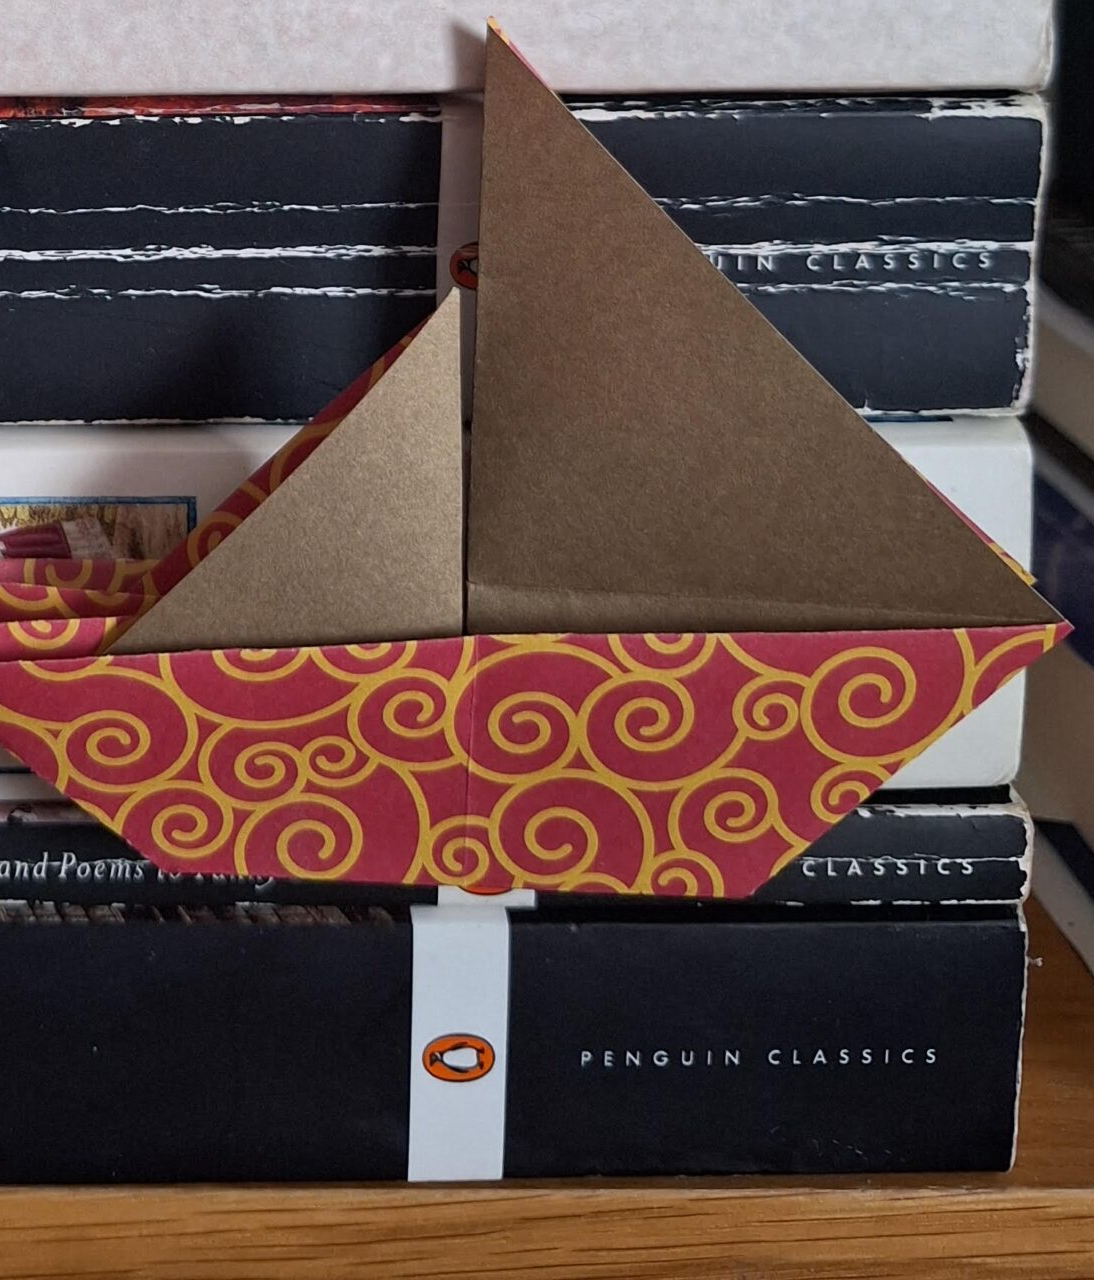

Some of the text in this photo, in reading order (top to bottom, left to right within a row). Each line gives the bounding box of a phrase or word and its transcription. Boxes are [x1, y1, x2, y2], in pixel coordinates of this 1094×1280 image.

[806, 250, 993, 273] CLASSICS
[58, 851, 145, 881] Poems
[802, 857, 975, 878] CLASSICS
[580, 1047, 938, 1068] PENGUIN CLASSICS
